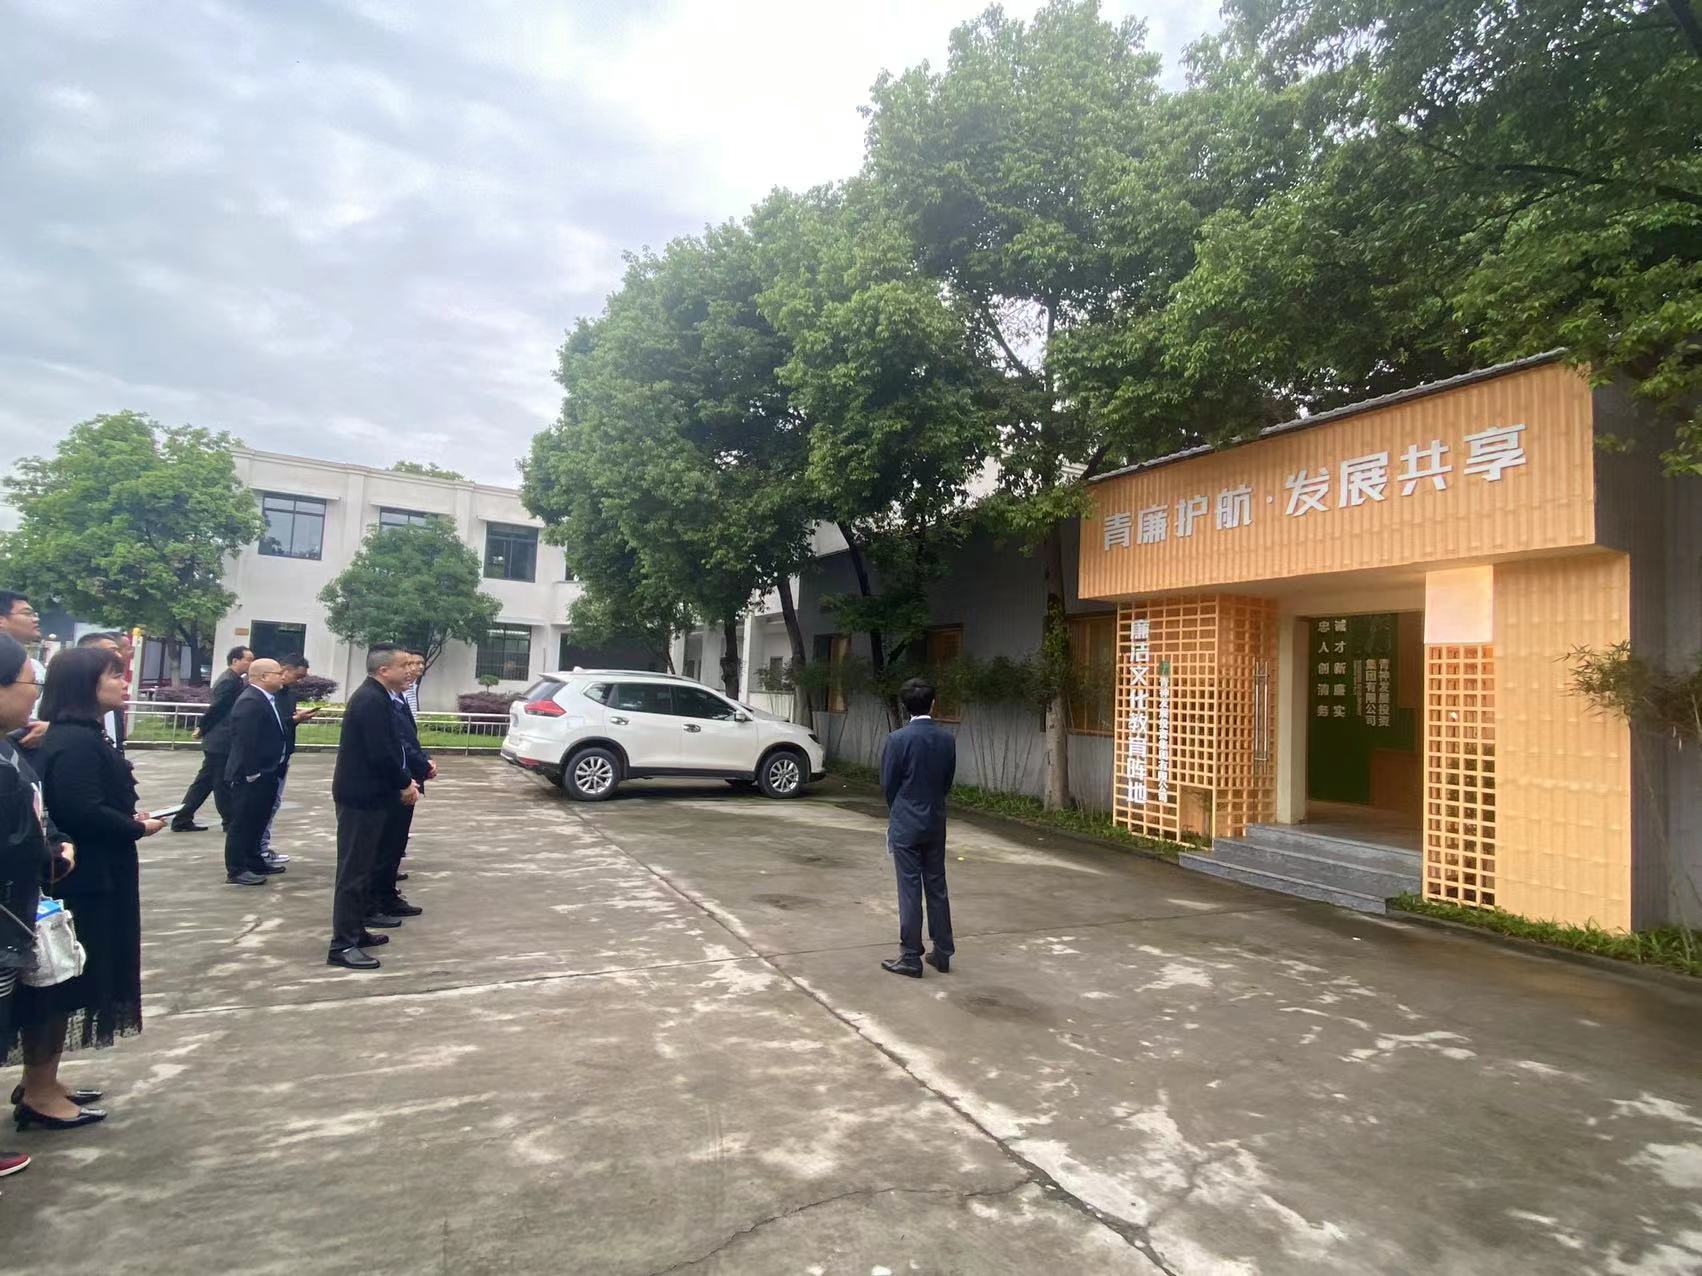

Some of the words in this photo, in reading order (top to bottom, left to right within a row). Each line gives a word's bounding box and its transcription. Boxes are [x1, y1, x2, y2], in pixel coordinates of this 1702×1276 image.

[1102, 423, 1528, 551] 青廉护航·发展共享
[1318, 641, 1347, 654] 人才
